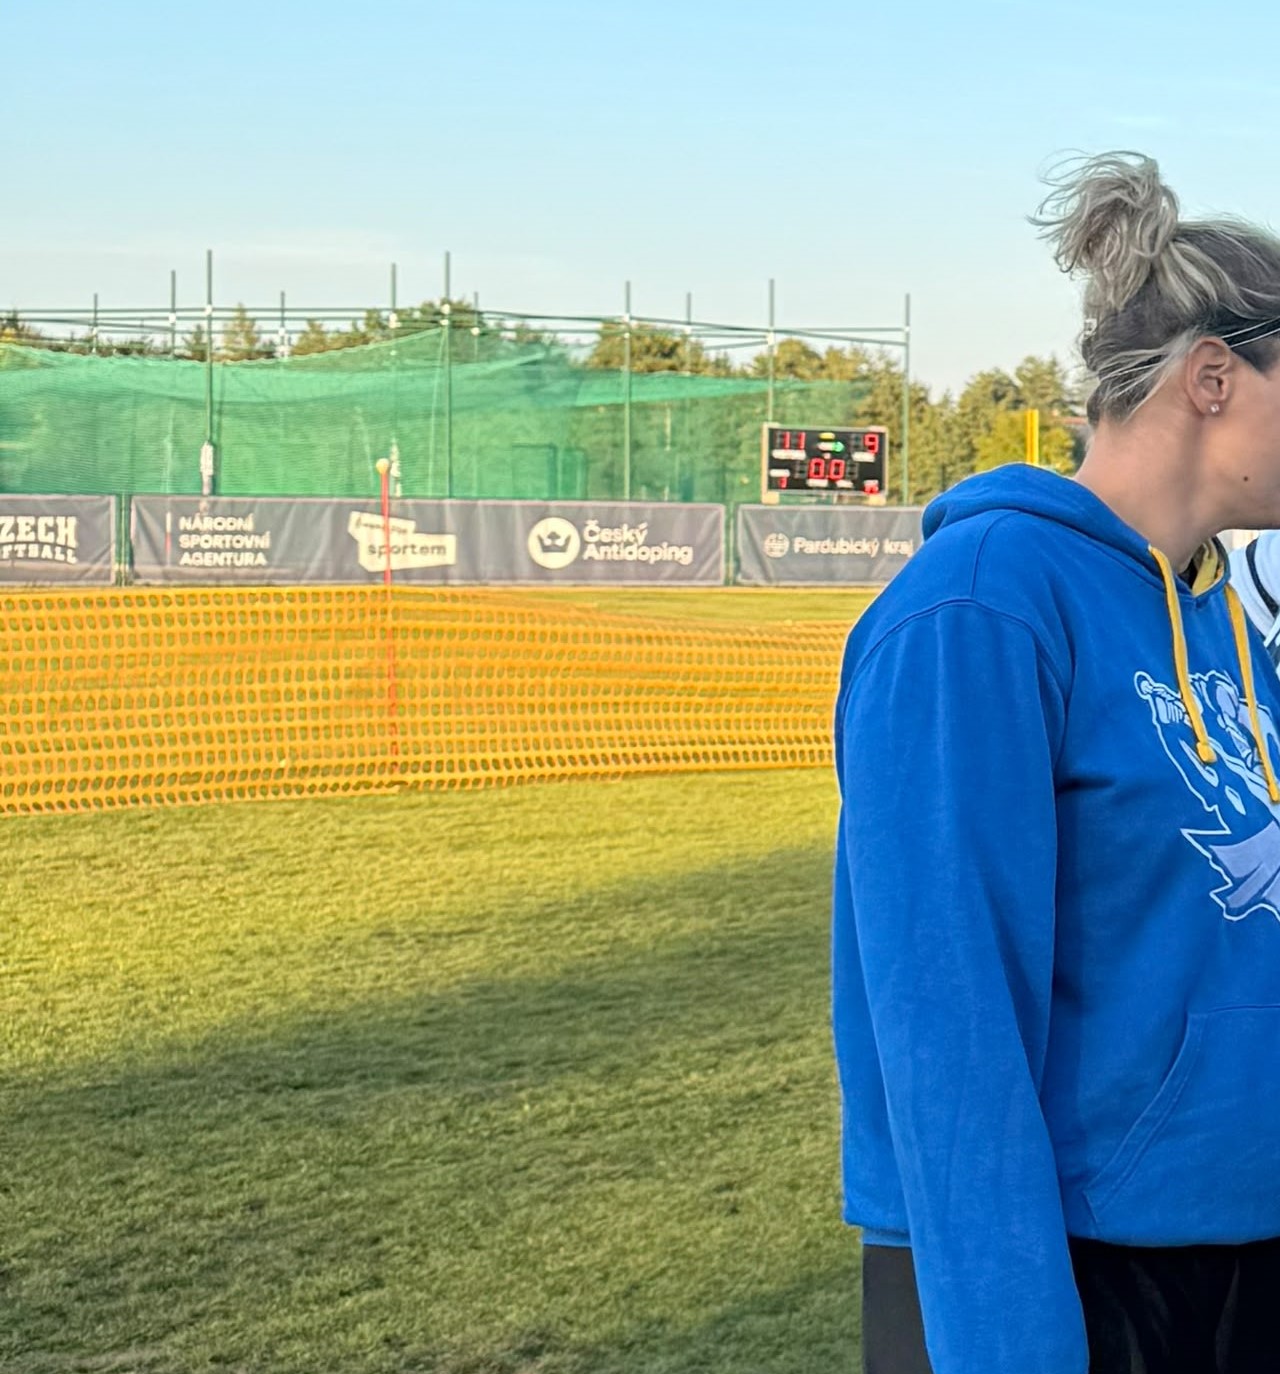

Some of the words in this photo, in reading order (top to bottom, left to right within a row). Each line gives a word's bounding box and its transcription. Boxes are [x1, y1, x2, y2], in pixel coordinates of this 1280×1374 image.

[0, 515, 79, 548] ZECH
[179, 513, 255, 533] NÁRODNÍ
[583, 520, 650, 545] Český
[179, 531, 271, 549] SPORTOVNÍ
[793, 535, 881, 558] Pardubický
[883, 537, 914, 558] kraj
[2, 544, 79, 565] FTBALL
[179, 551, 268, 567] AGENTURA
[582, 540, 695, 566] Antidoping
